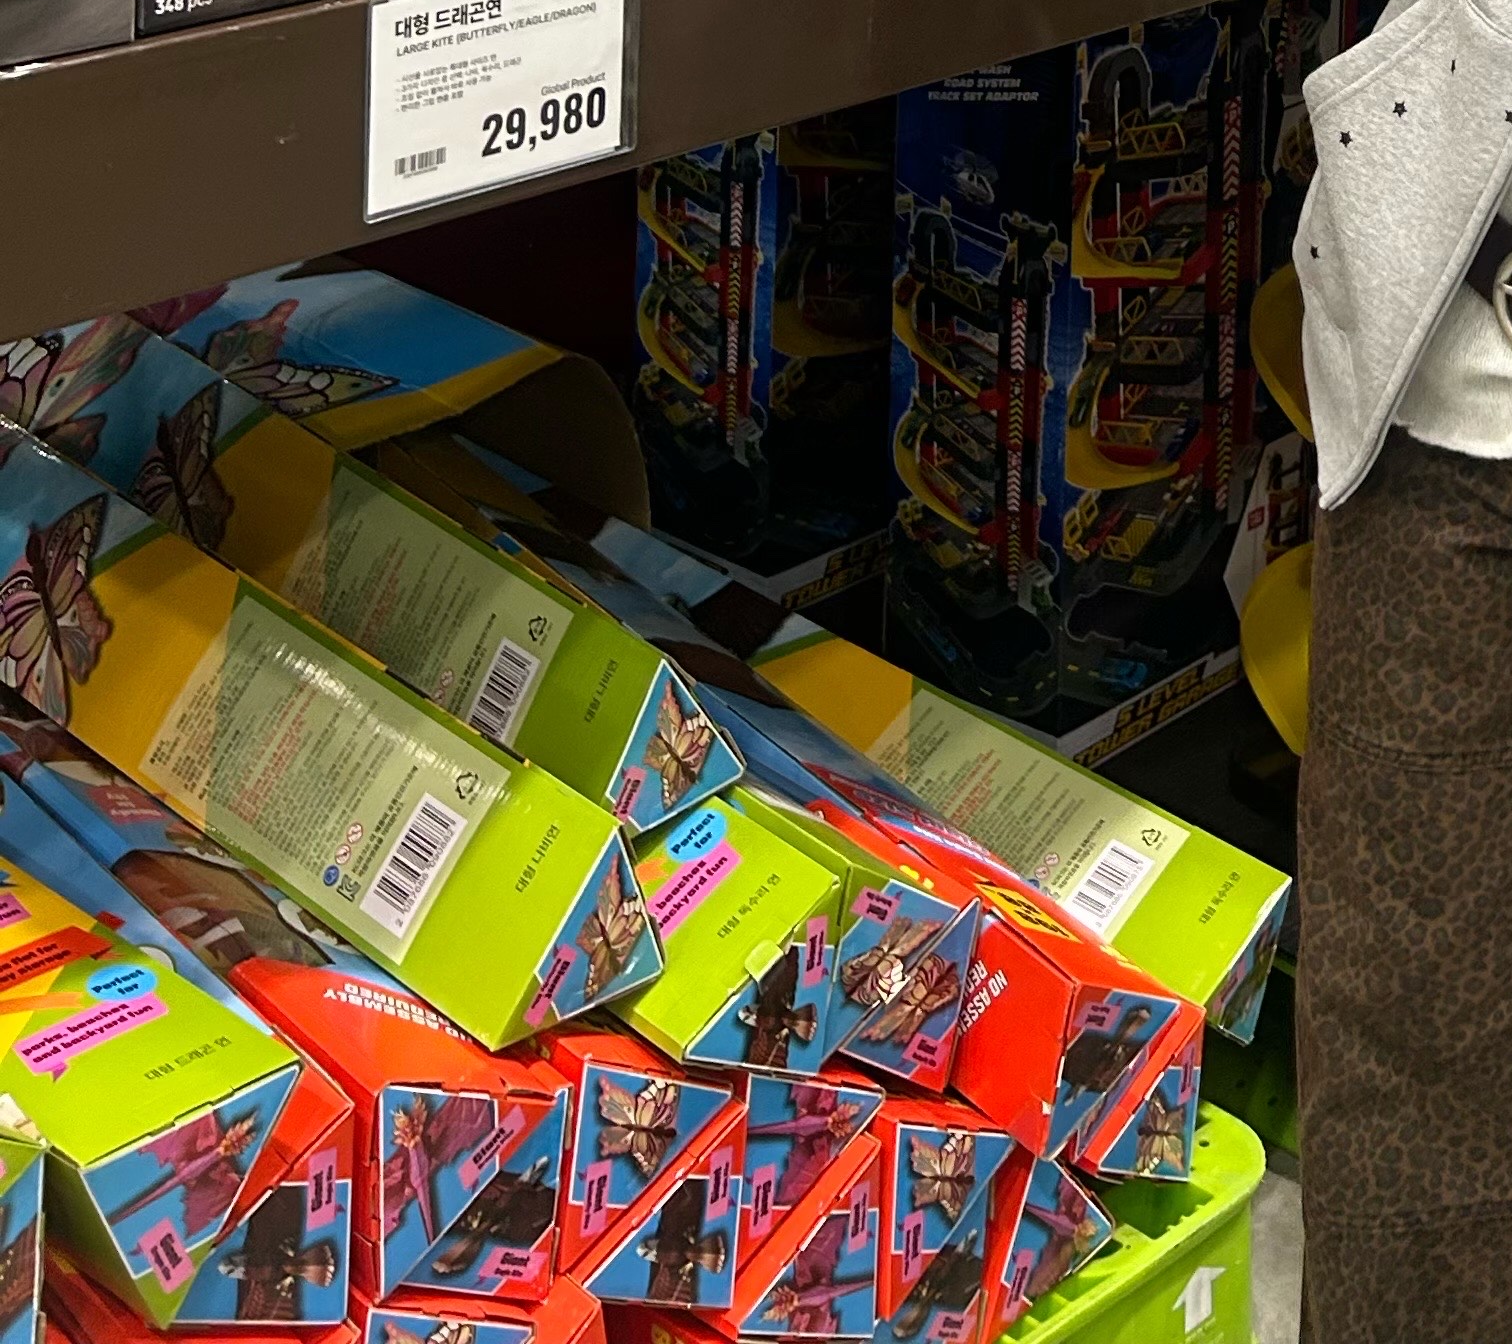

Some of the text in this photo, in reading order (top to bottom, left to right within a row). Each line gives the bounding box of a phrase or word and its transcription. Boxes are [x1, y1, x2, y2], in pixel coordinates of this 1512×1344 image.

[395, 13, 429, 38] 대형
[396, 35, 454, 57] LARGE KITE
[541, 72, 606, 96] Global Product
[976, 78, 1021, 89] SYSTEM
[482, 86, 606, 158] 29,980
[671, 812, 716, 854] Perfect
[694, 830, 714, 849] for
[515, 823, 561, 893] 대형 나비연
[706, 855, 728, 877] fun
[656, 858, 707, 910] beaches
[717, 915, 740, 939] 대형
[18, 948, 72, 972] storage
[38, 942, 59, 956] for
[92, 968, 145, 994] Perfect
[118, 982, 140, 996] for
[67, 1003, 130, 1033] beaches
[33, 1004, 153, 1063] and backyard fun
[144, 1044, 216, 1080] 대형 드래곤
